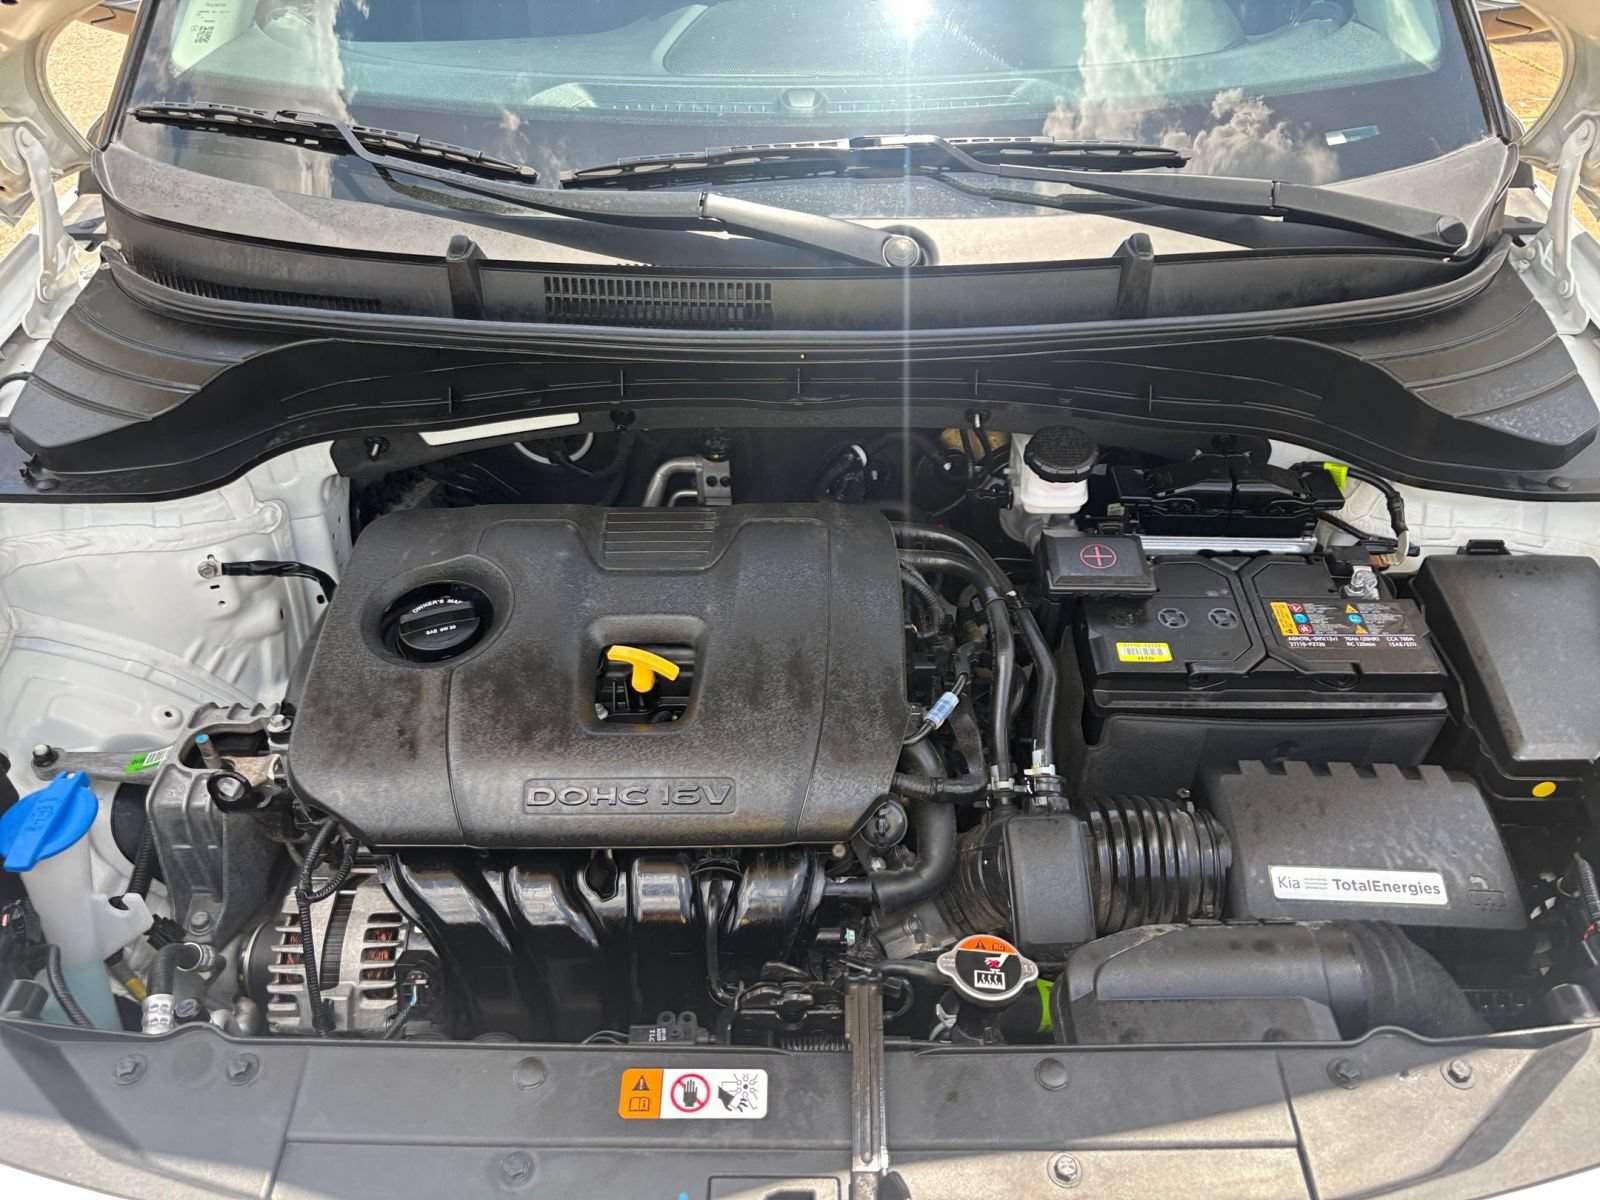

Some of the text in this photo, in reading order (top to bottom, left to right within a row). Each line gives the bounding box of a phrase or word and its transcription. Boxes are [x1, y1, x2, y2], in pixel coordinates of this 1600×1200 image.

[412, 599, 445, 613] OWNER'S
[526, 785, 732, 807] DOHC 16V
[1278, 876, 1301, 889] Kia
[1331, 878, 1441, 896] TotalEnergies
